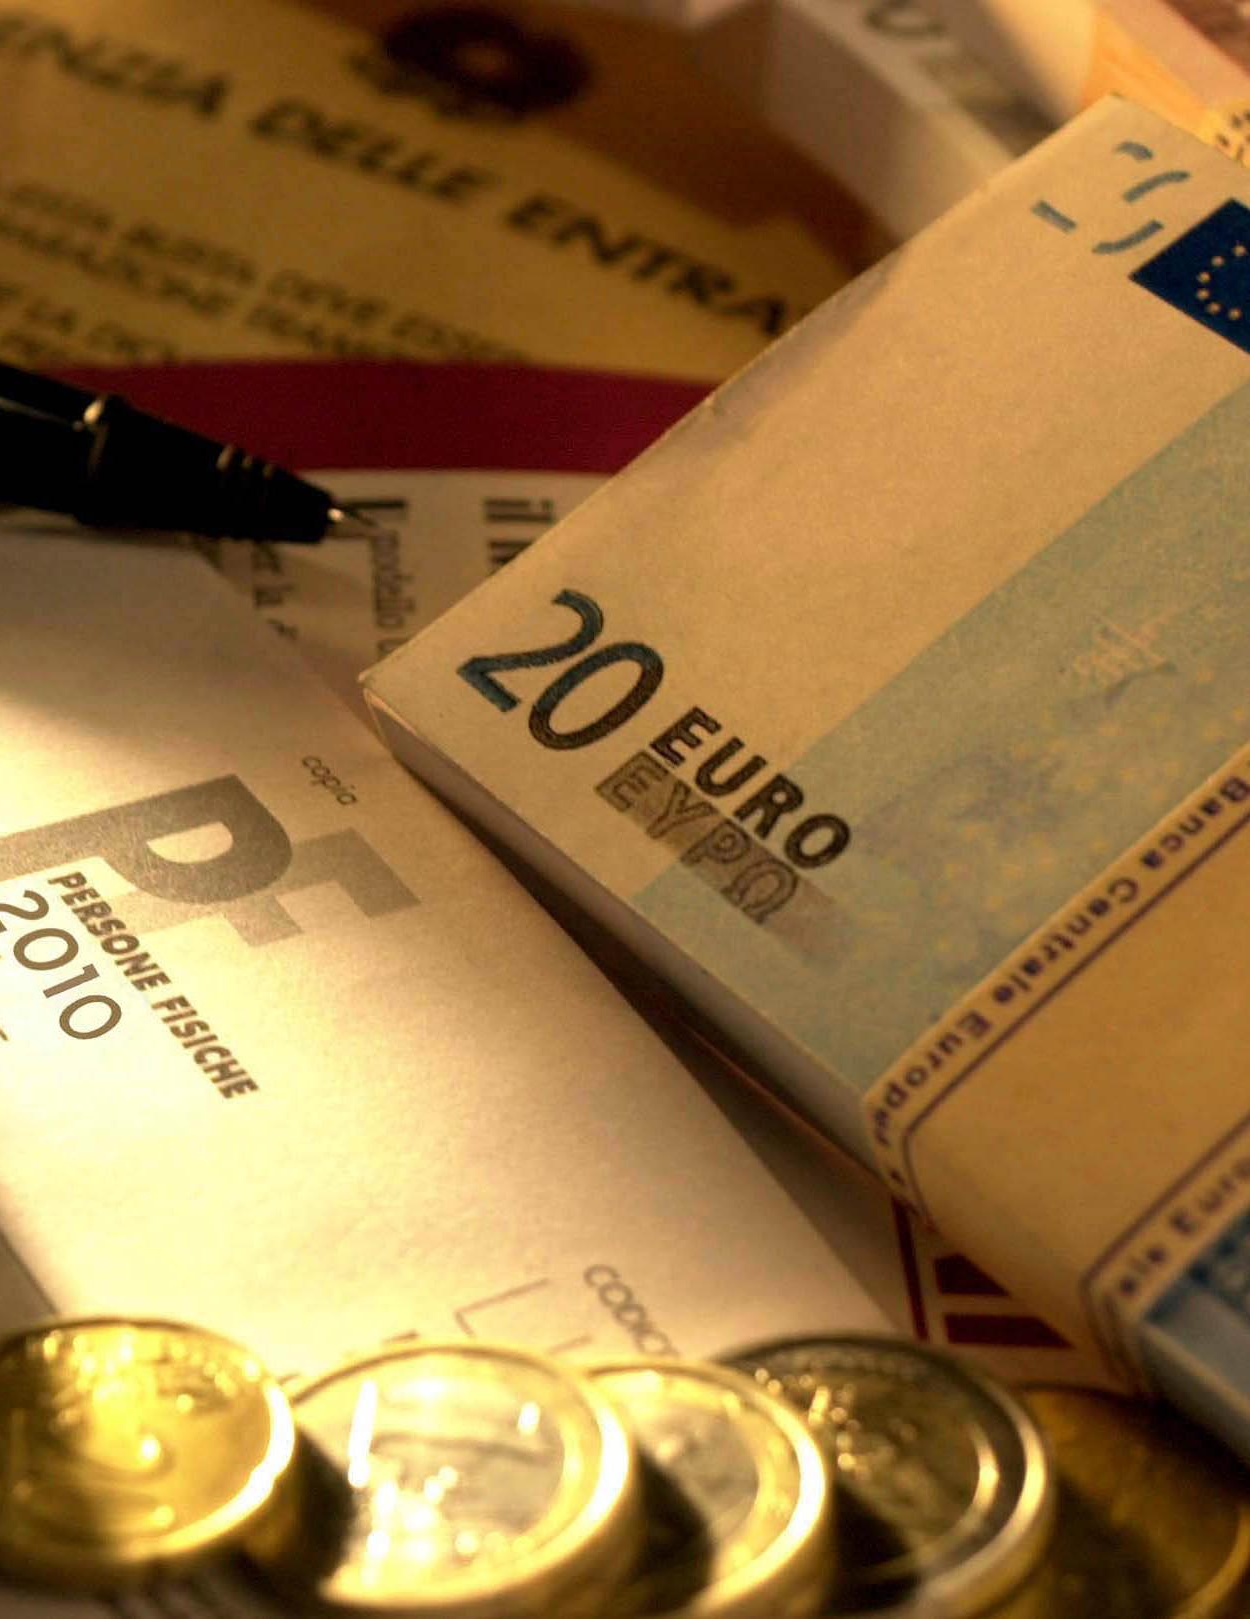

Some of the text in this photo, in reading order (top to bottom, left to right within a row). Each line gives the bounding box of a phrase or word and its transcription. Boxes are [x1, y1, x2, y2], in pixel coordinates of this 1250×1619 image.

[456, 589, 665, 752] 20
[650, 706, 852, 869] EURO
[1140, 770, 1250, 872] Banca
[47, 871, 260, 1100] PERSONE FISICHE
[993, 877, 1140, 1006] Centrale
